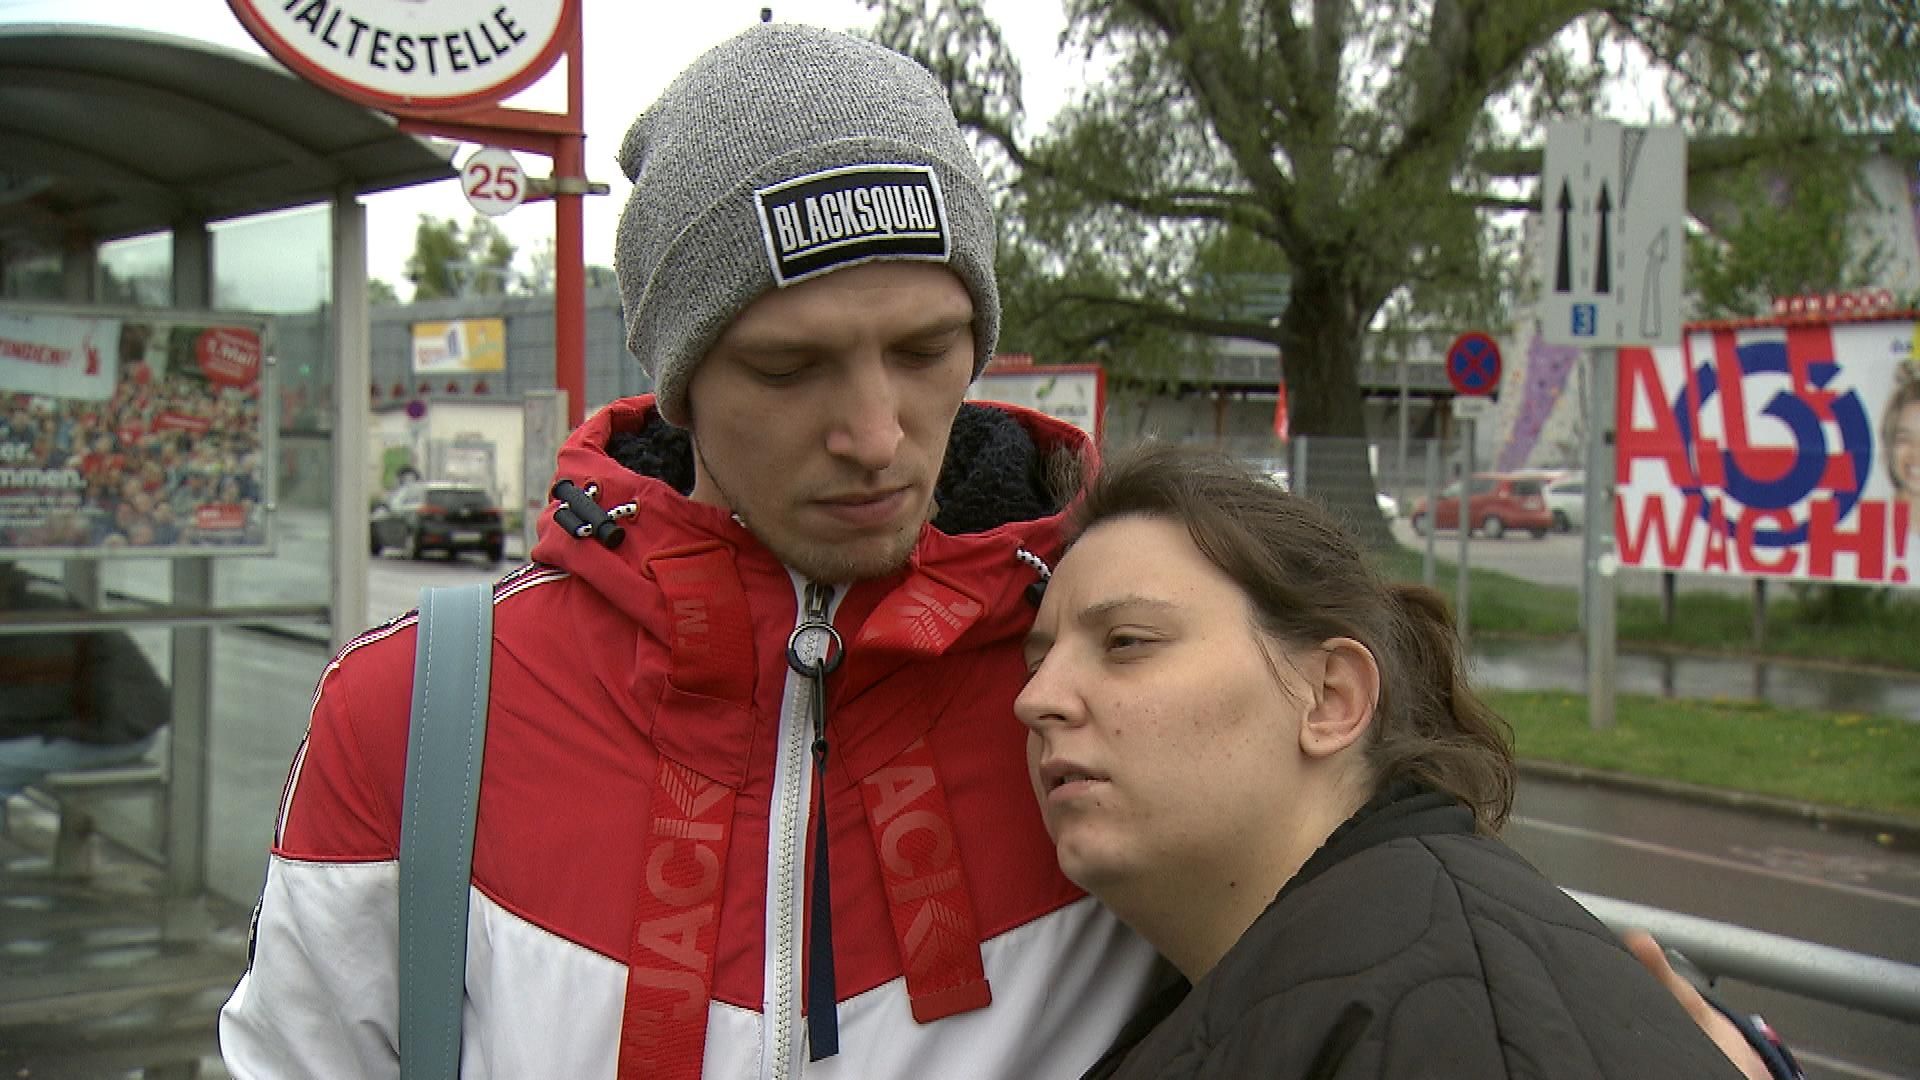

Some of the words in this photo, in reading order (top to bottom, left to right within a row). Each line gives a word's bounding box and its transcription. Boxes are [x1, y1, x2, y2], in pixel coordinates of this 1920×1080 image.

[468, 164, 519, 201] 25
[772, 185, 937, 254] BLACKSQUAD
[1615, 493, 1911, 583] WACH!
[632, 757, 732, 1022] JACK
[862, 736, 968, 975] ACK
